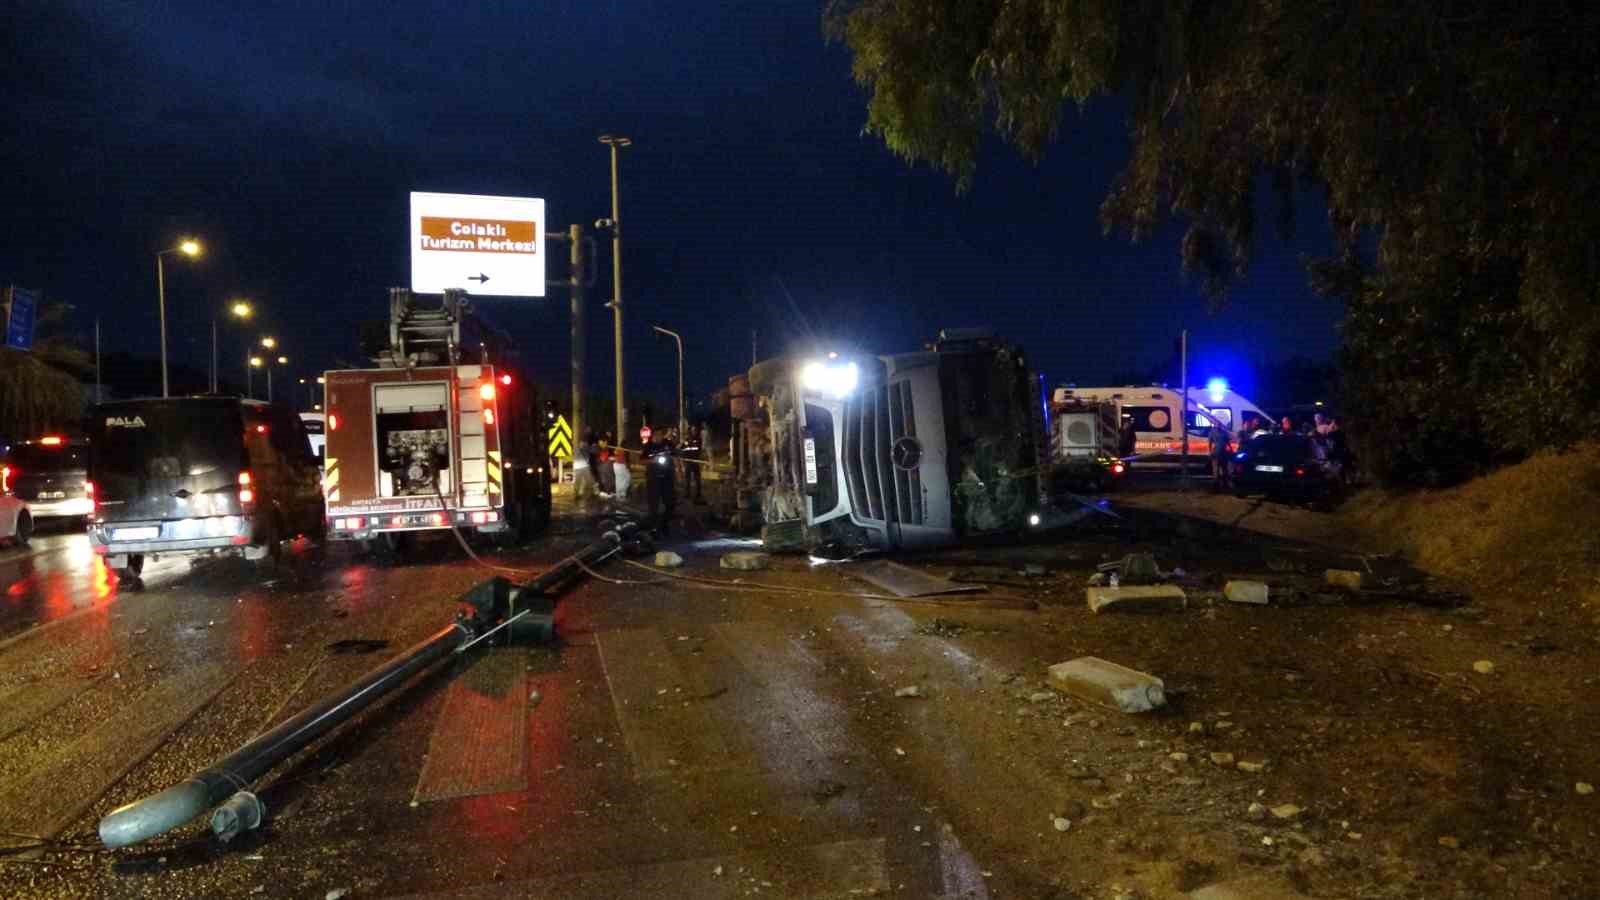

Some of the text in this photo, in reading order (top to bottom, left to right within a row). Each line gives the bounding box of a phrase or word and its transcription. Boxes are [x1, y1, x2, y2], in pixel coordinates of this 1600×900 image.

[451, 222, 507, 236] Çolaklı
[421, 235, 536, 252] Turizm Merkezi
[105, 416, 145, 427] PALA
[1136, 440, 1169, 449] MBULANS
